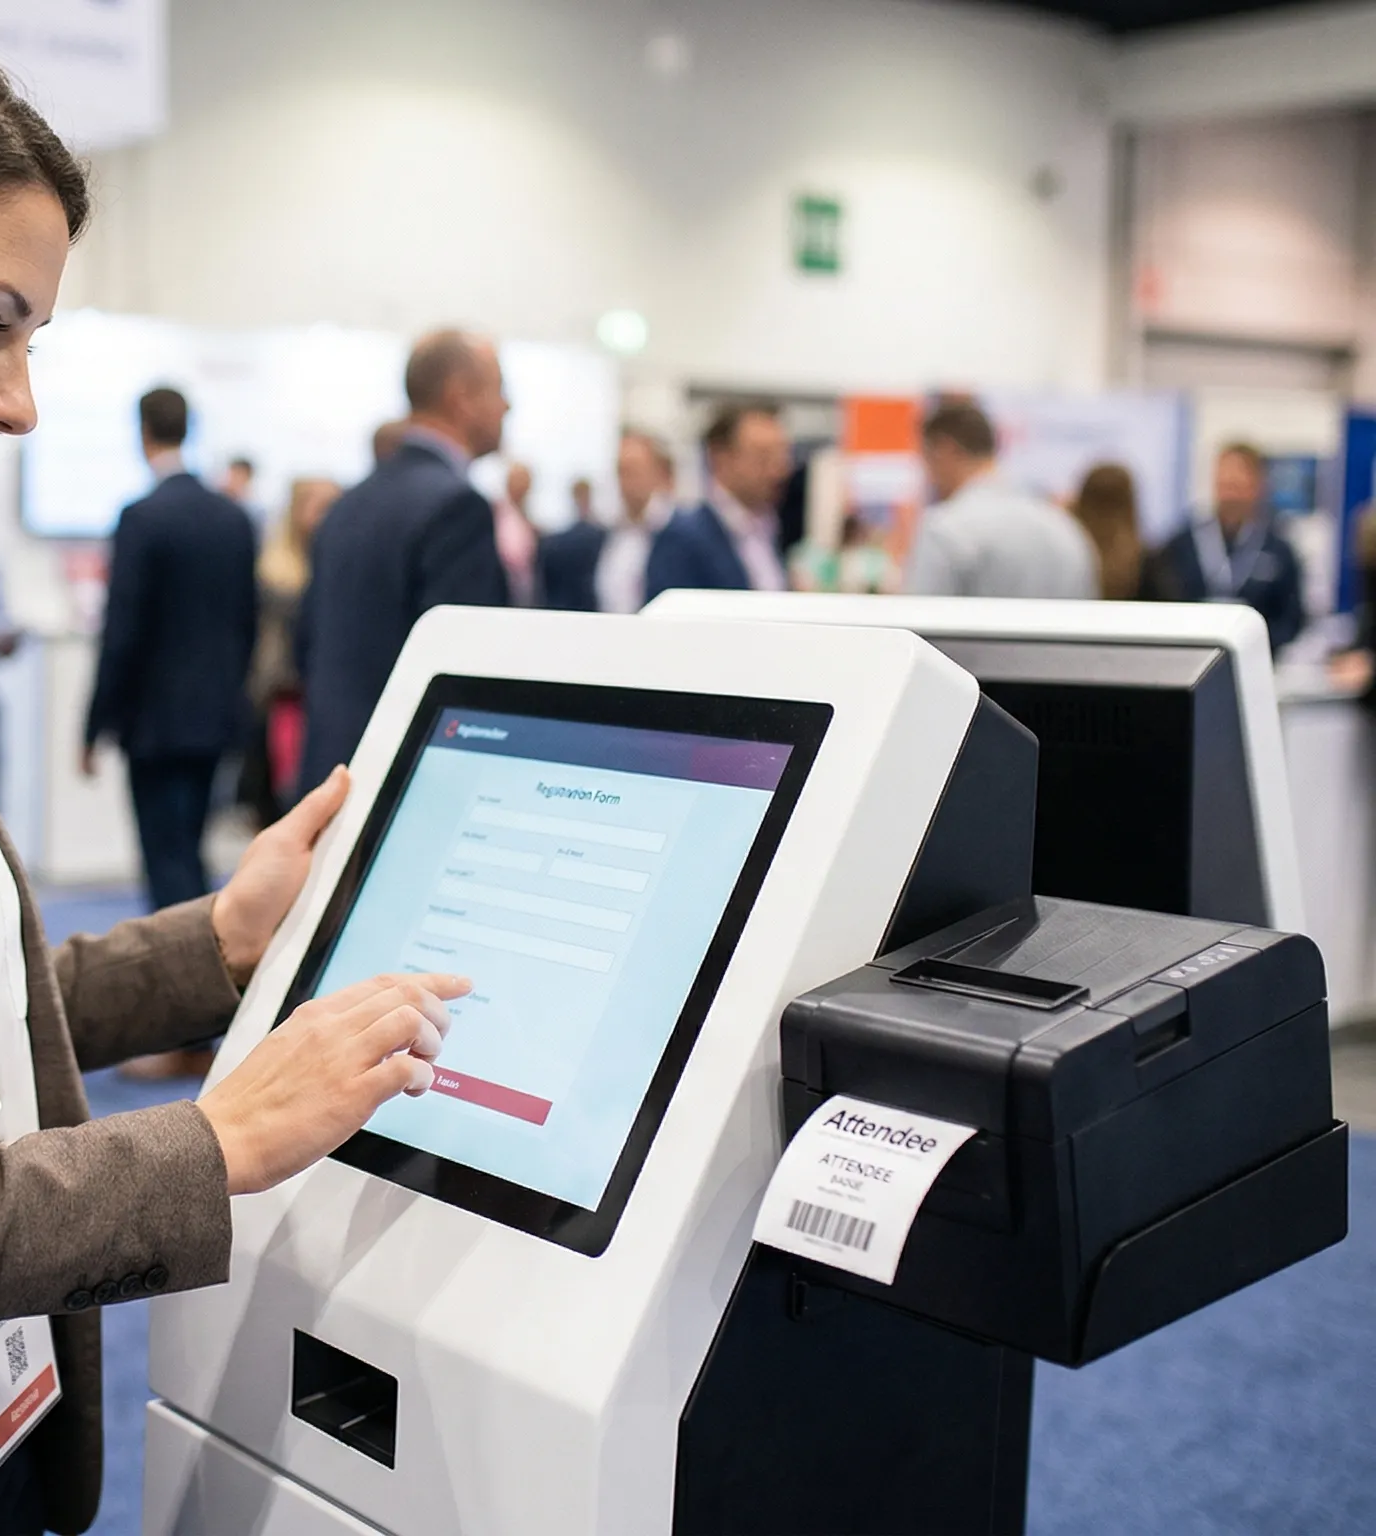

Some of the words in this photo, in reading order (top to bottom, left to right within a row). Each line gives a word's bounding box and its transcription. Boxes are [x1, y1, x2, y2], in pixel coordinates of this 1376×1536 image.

[592, 790, 621, 804] Form
[823, 1110, 937, 1153] Attendee
[818, 1153, 895, 1183] ATTENDEE
